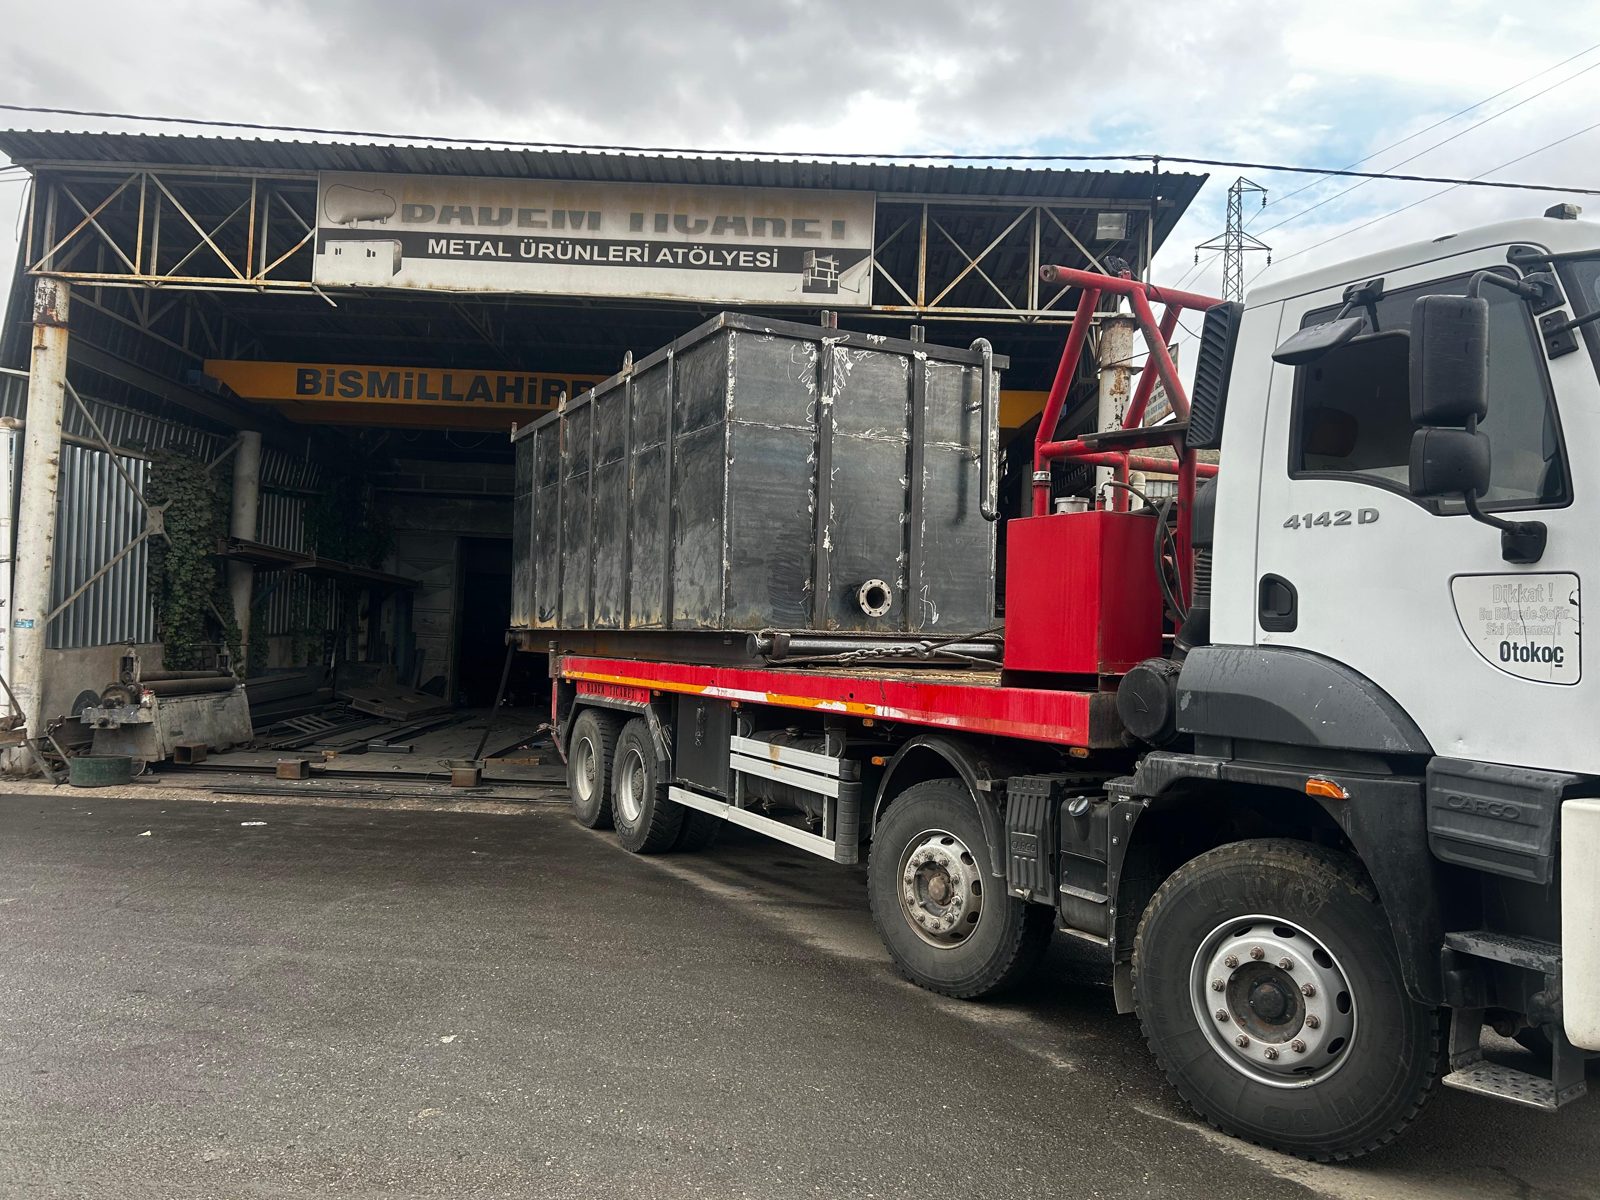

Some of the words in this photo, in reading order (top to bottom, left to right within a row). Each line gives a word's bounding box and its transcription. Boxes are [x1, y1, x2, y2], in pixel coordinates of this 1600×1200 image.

[427, 238, 512, 257] METAL
[520, 239, 649, 263] ÜRÜNLERİ
[655, 246, 779, 268] ATÖLYESİ
[1283, 510, 1351, 529] 4142
[1358, 508, 1380, 524] D
[1492, 584, 1543, 603] Dikkat
[1499, 640, 1564, 668] Otokoç
[1447, 794, 1520, 819] CARGO
